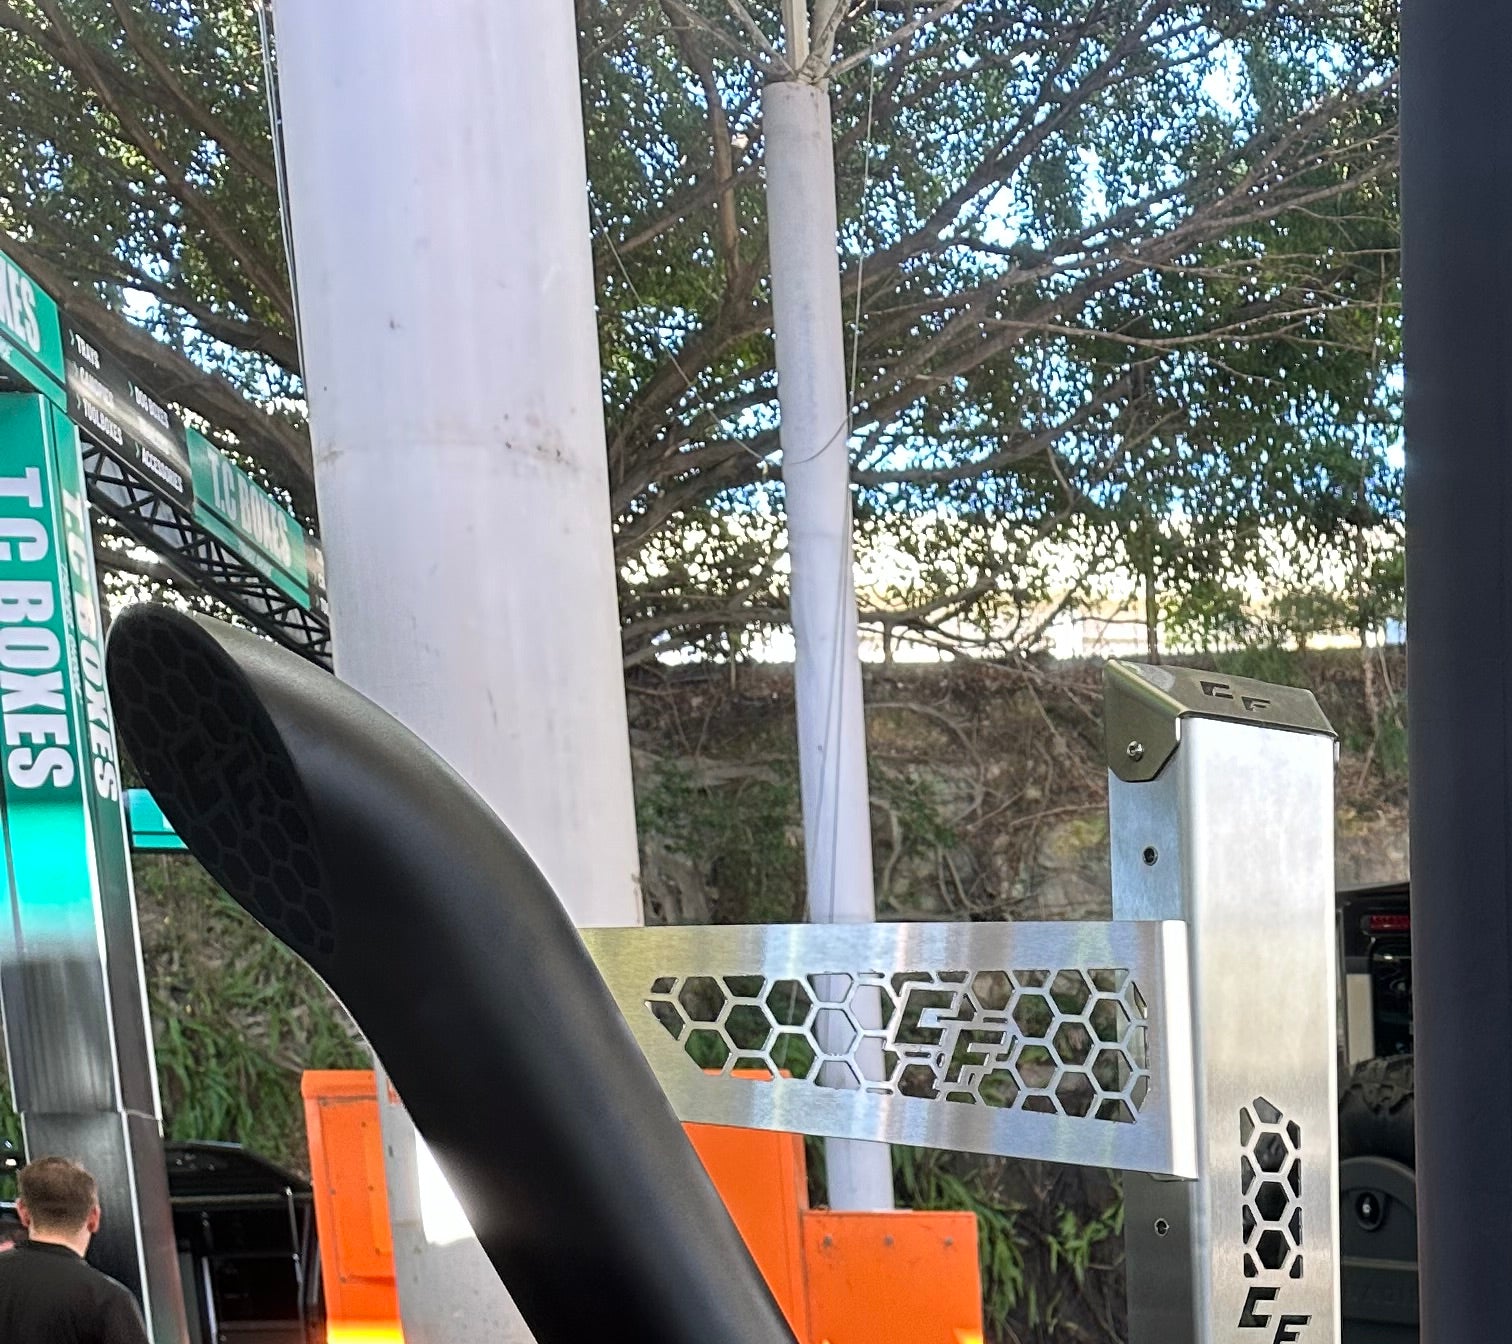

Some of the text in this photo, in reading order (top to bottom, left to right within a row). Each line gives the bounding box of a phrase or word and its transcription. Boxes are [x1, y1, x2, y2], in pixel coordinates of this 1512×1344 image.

[237, 472, 293, 568] BOXES
[0, 580, 75, 788] BOXES
[75, 591, 118, 802] BOXES
[1200, 681, 1271, 711] CF
[894, 988, 1008, 1083] CF
